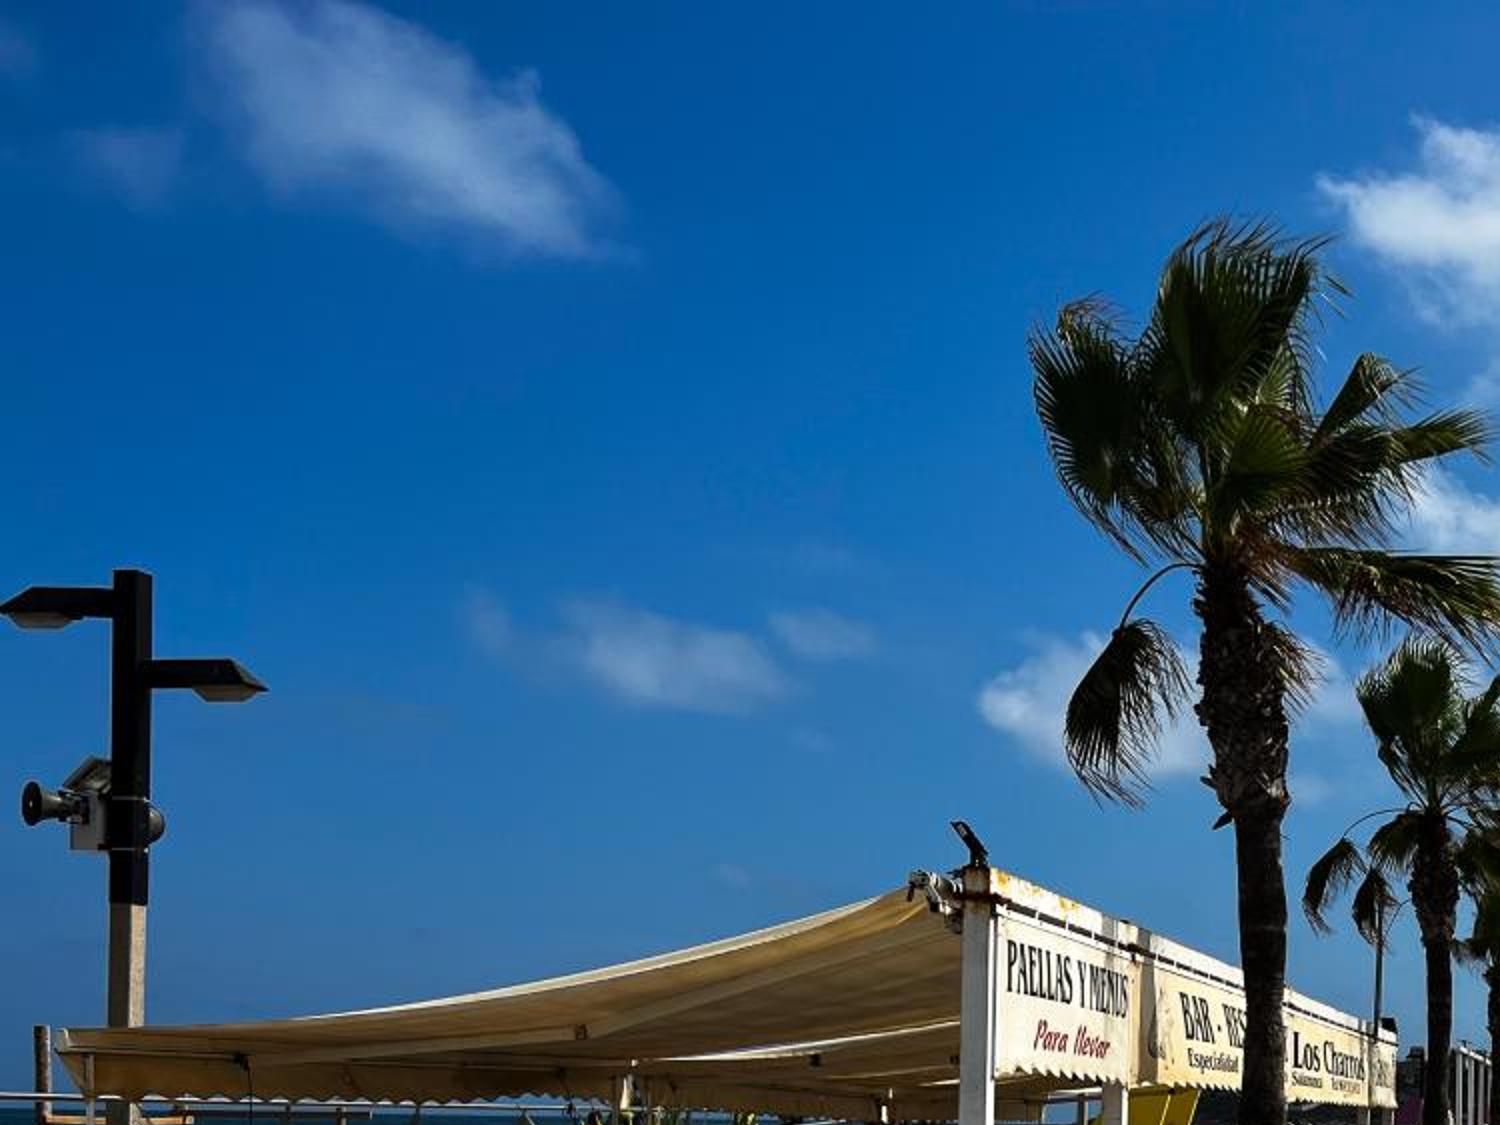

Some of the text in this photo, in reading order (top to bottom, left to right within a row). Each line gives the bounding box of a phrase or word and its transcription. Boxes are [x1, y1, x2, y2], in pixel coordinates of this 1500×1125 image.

[1006, 938, 1073, 1005] PAELLAS
[1077, 959, 1087, 1008] Y
[1033, 1018, 1111, 1060] Para llevar
[1178, 991, 1216, 1045] BAR
[1292, 1031, 1321, 1073] Los
[1323, 1040, 1366, 1082] Charros
